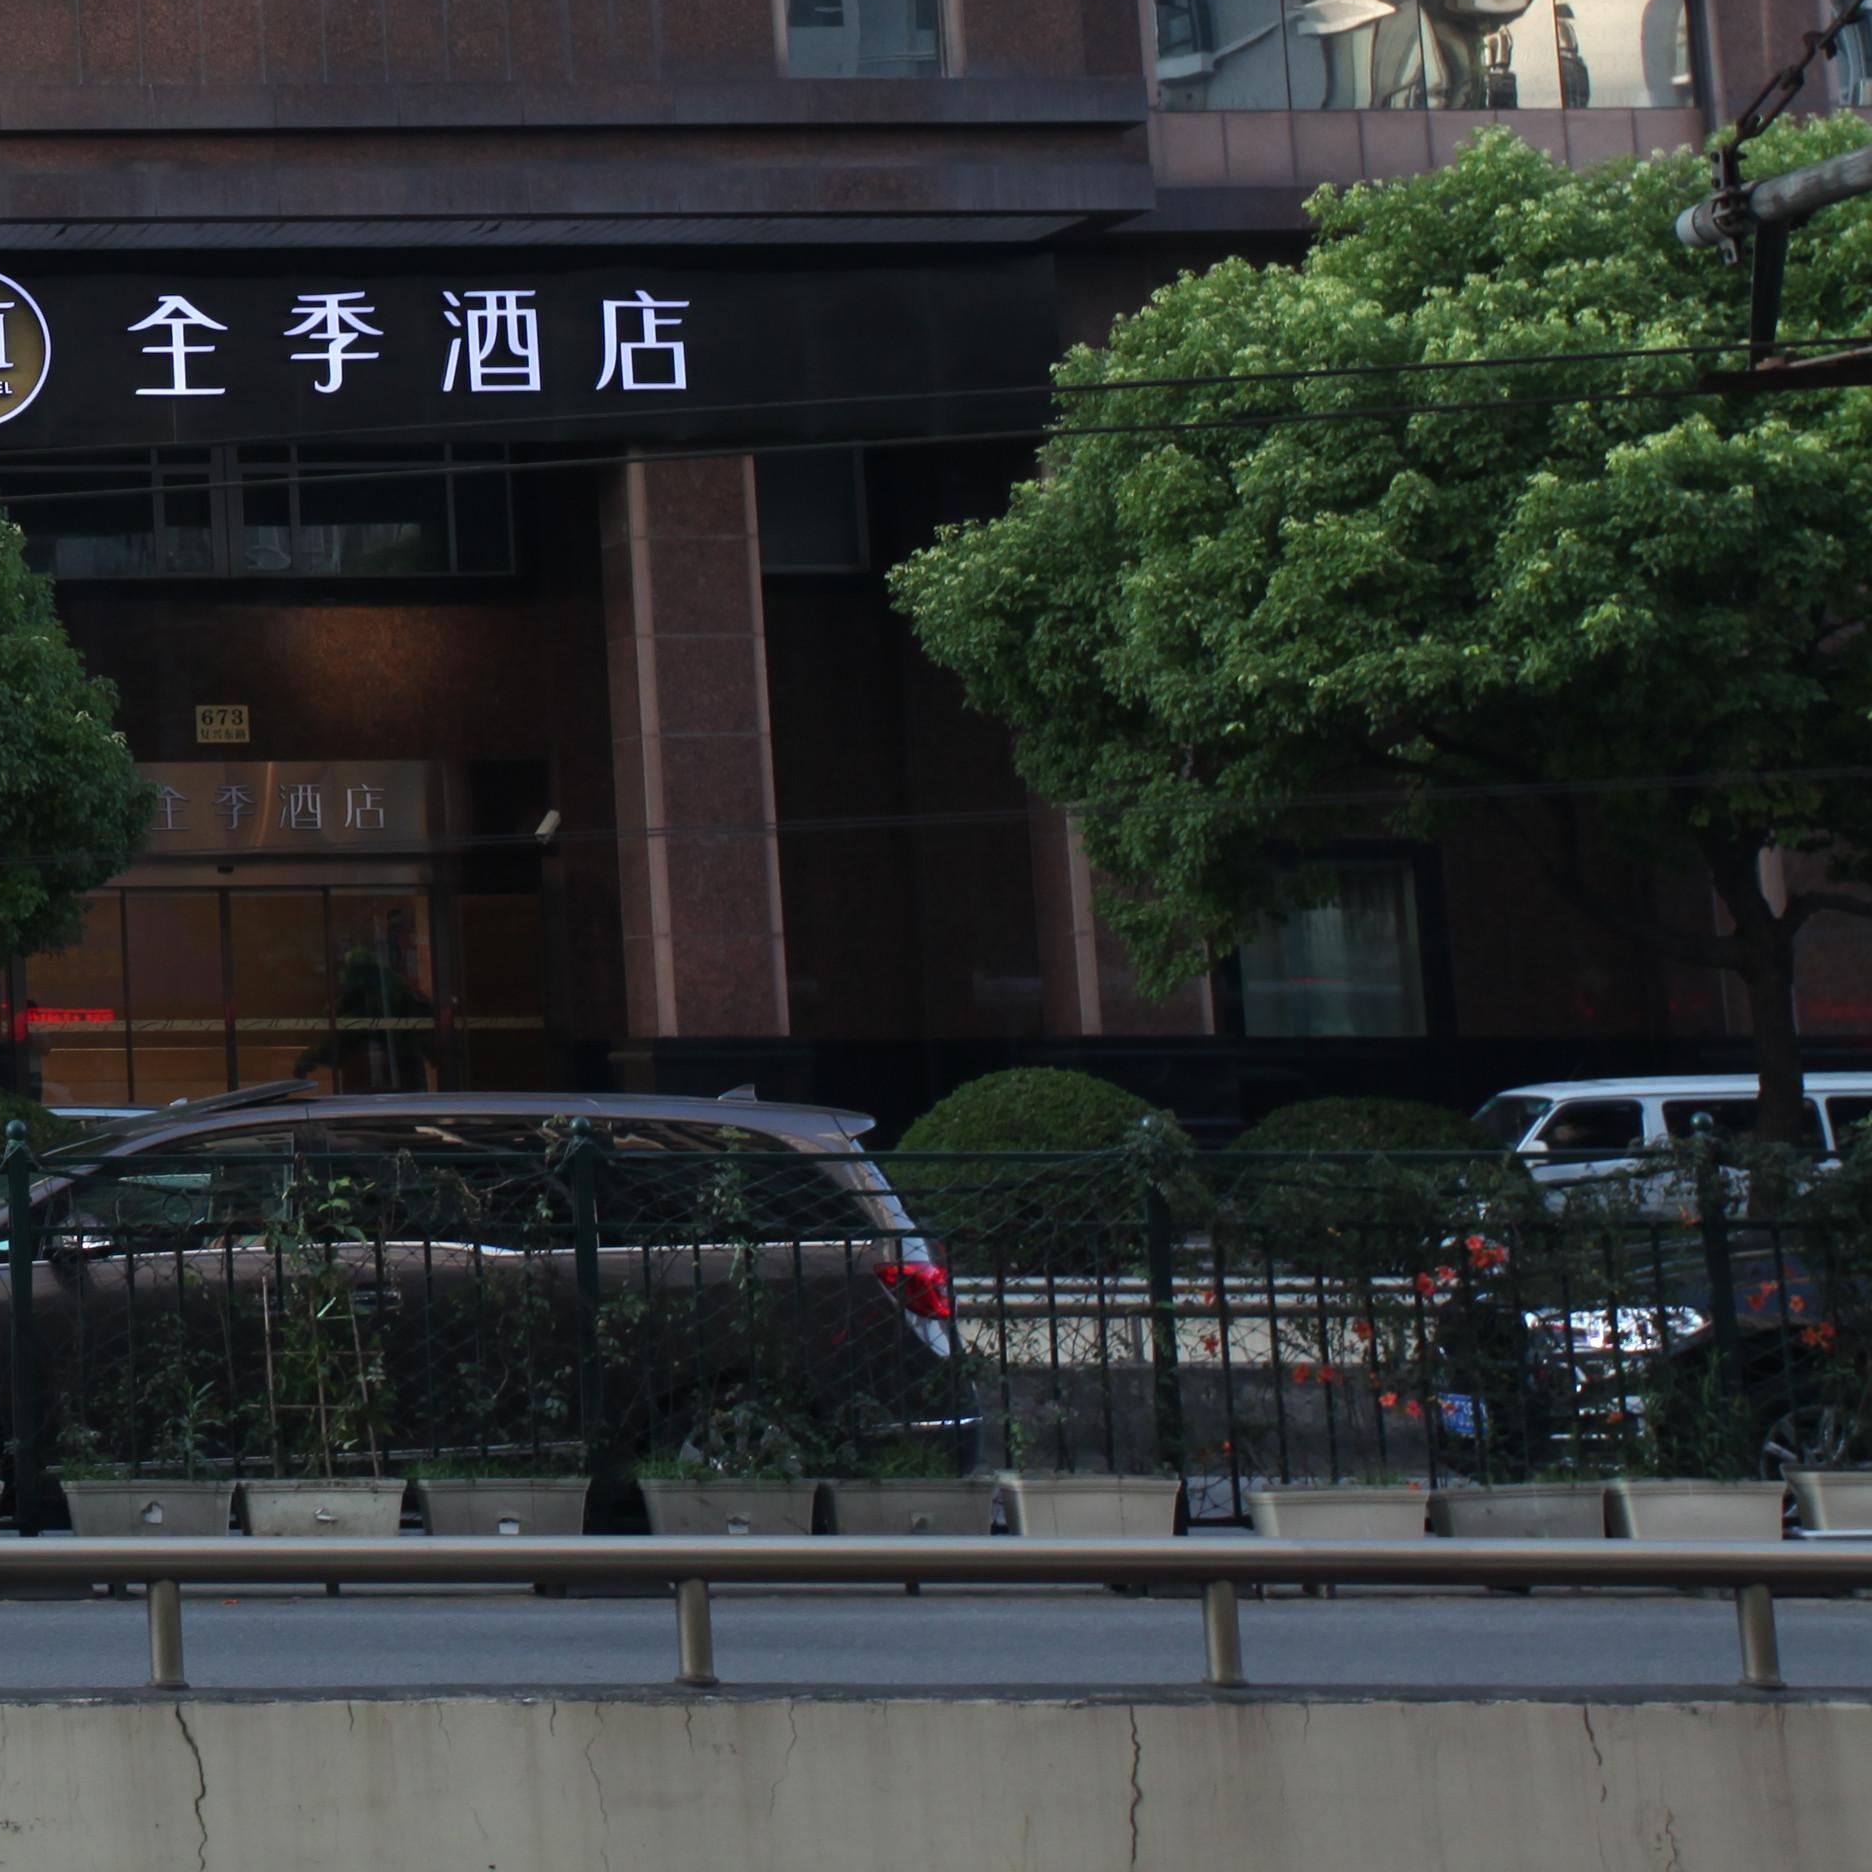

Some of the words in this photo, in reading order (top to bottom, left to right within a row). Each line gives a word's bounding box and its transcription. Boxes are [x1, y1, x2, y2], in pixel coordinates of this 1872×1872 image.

[127, 289, 691, 396] 全季酒店
[201, 709, 244, 726] 673
[150, 783, 385, 832] 全季酒店
